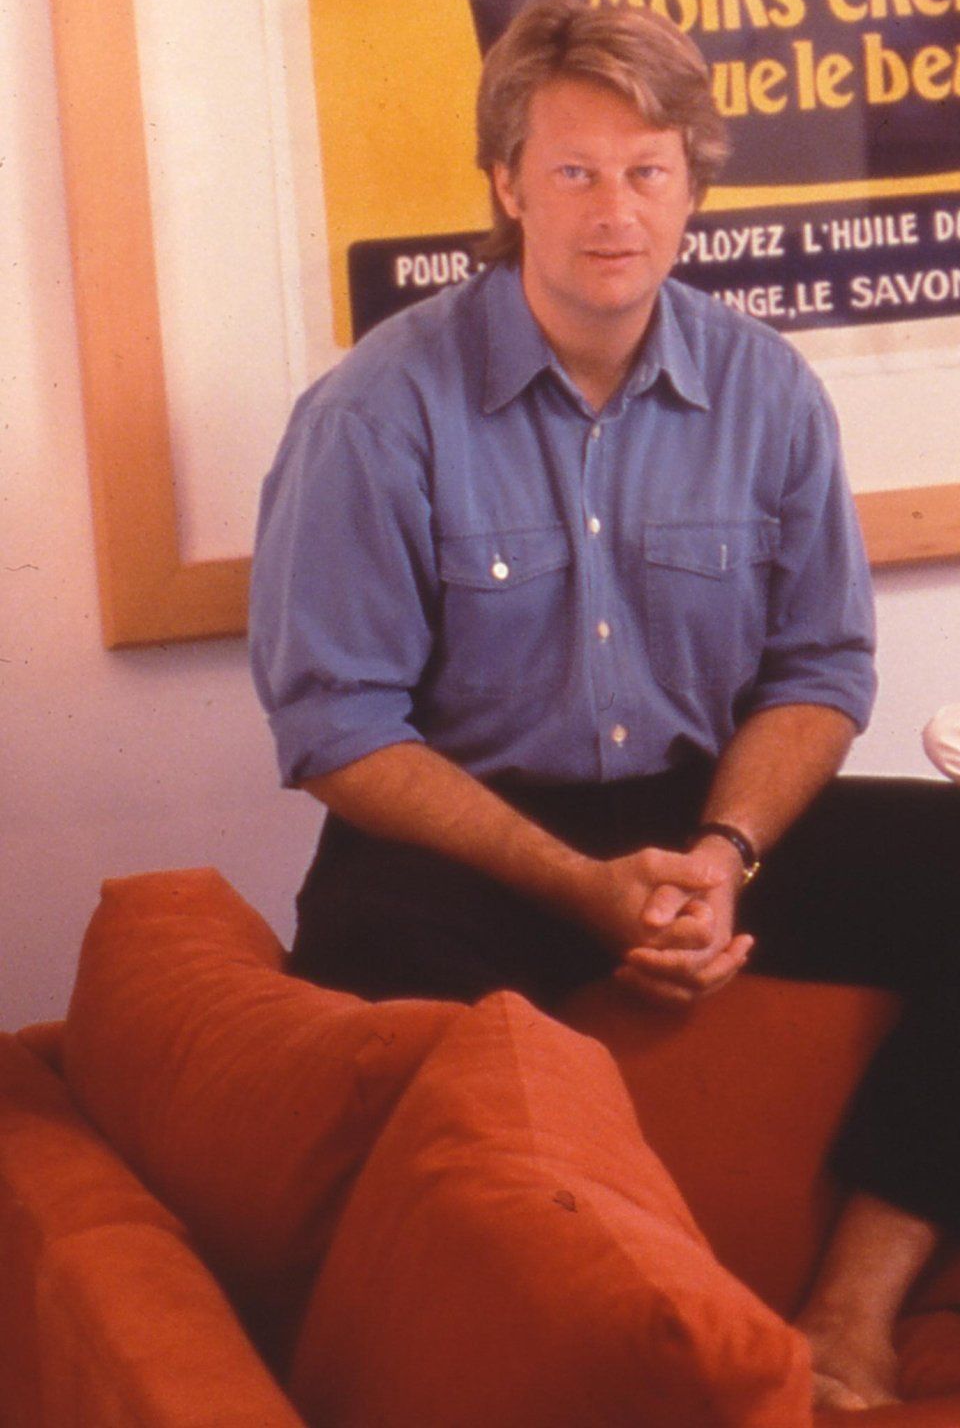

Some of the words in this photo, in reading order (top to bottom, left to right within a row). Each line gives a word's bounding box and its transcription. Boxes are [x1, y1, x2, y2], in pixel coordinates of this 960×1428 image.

[710, 59, 788, 116] ue
[396, 250, 471, 287] POUR
[677, 224, 785, 264] PLOYEZ
[803, 213, 920, 254] L'HUILE
